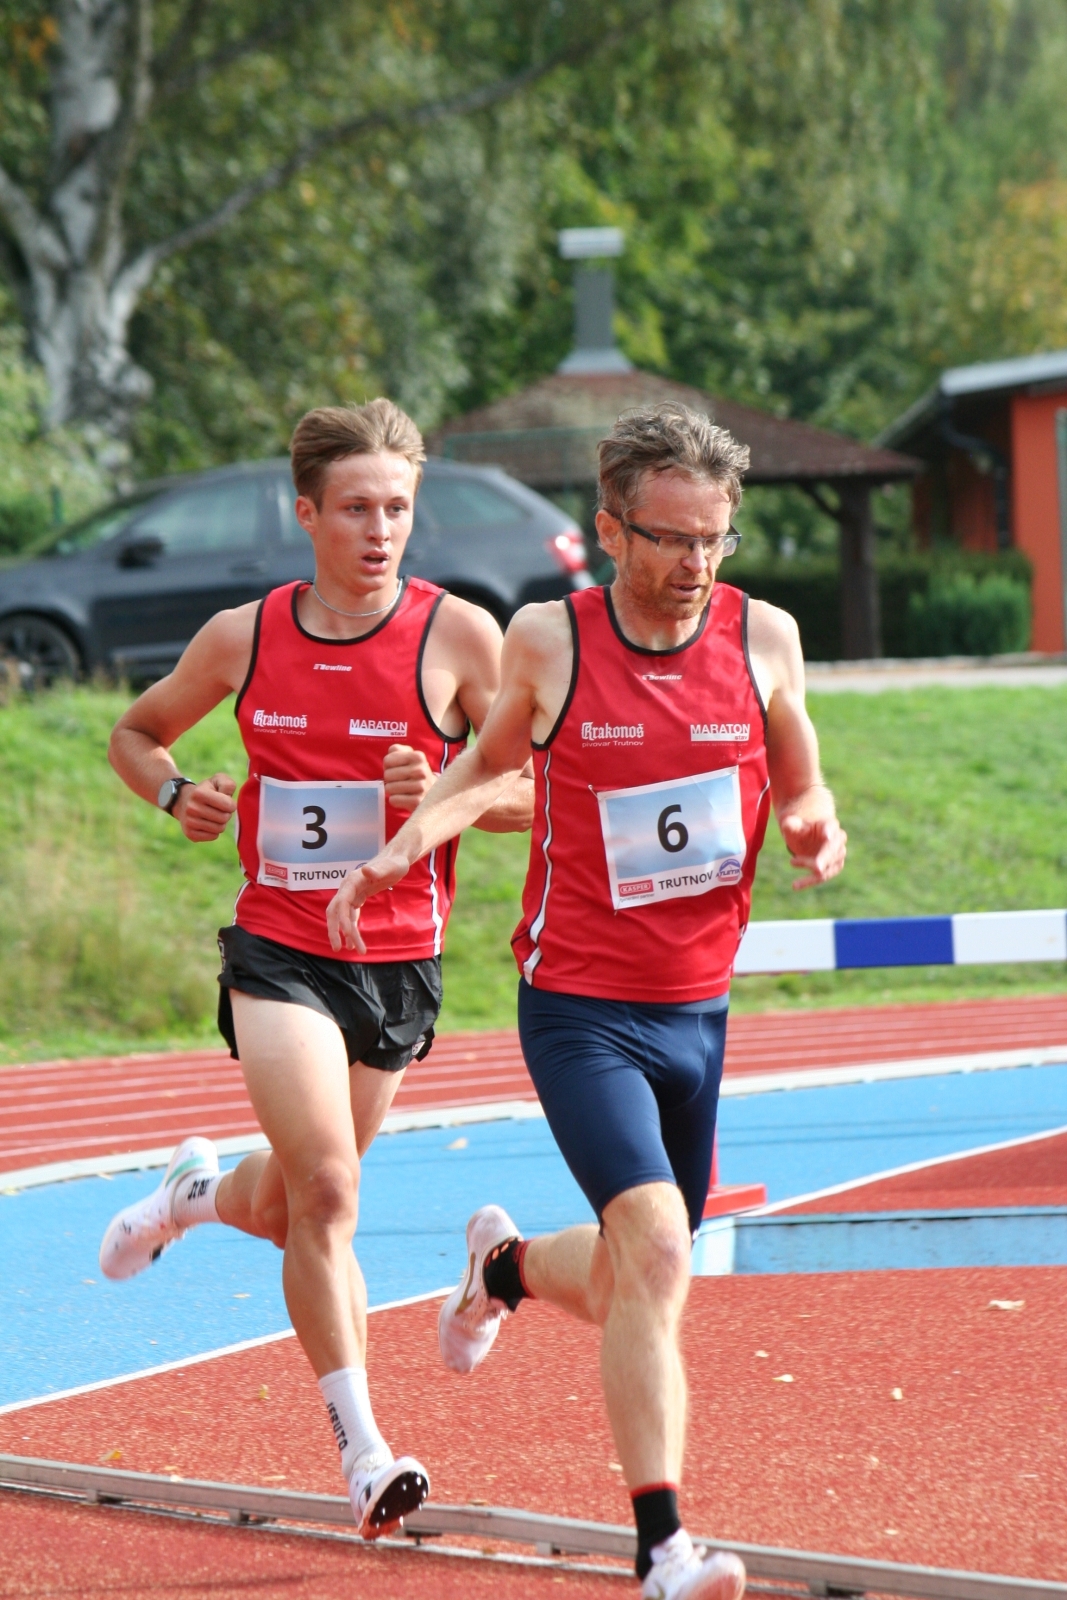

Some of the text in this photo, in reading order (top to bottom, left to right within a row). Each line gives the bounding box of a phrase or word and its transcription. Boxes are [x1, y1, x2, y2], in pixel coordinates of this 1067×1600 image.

[253, 709, 307, 729] Krakonoš
[349, 718, 407, 731] MARATON
[279, 728, 306, 736] Trutnov
[581, 722, 644, 741] Krakonoš
[690, 723, 751, 735] MARATON
[302, 805, 328, 850] 3
[658, 804, 688, 852] 6
[292, 869, 347, 881] TRUTNOV
[658, 870, 714, 891] TRUTNOV
[621, 884, 648, 893] KASPER
